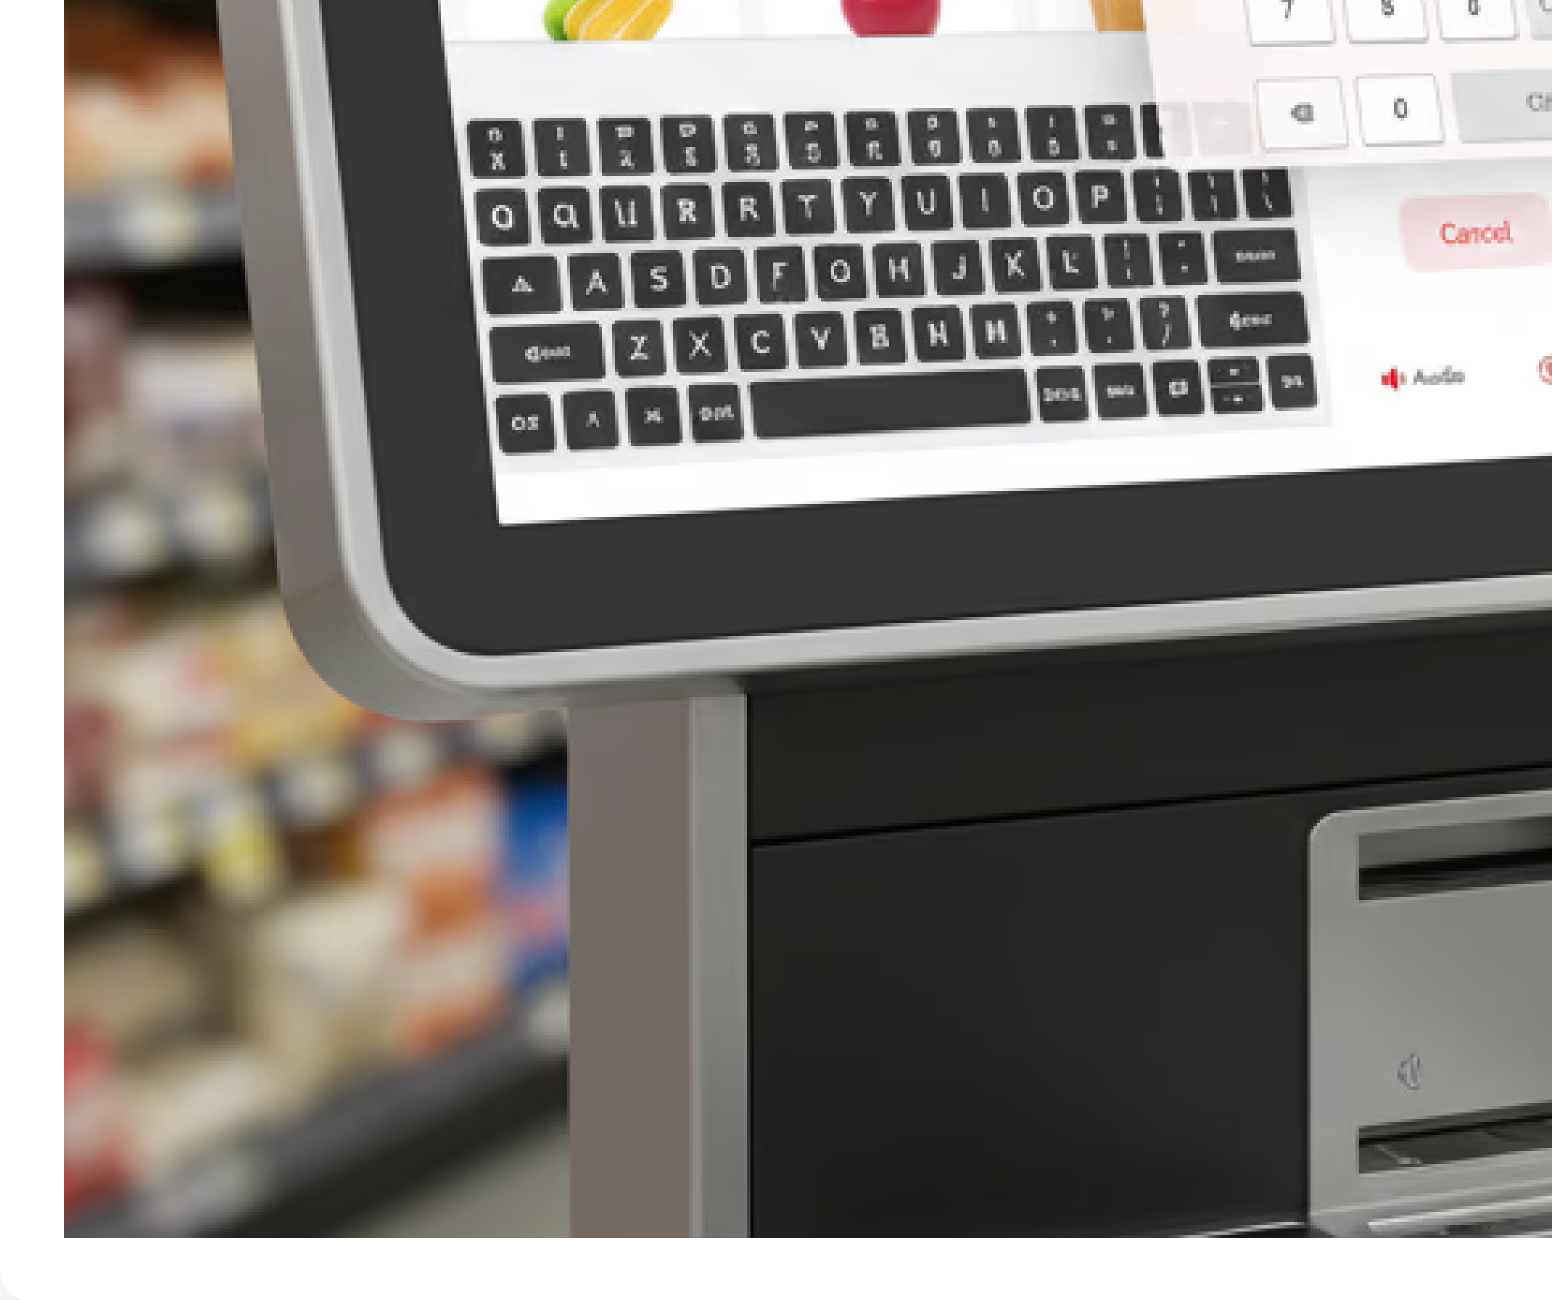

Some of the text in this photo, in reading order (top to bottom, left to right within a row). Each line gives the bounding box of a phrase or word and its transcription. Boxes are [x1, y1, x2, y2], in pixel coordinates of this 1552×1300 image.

[1281, 0, 1294, 18] 7
[1394, 98, 1407, 121] 0
[798, 195, 818, 218] T
[860, 192, 876, 215] Y
[917, 189, 934, 215] U
[1091, 185, 1108, 208] P
[740, 198, 757, 221] R
[953, 256, 966, 279] J
[1005, 250, 1024, 276] K
[586, 269, 606, 295] A
[650, 266, 667, 291] S
[711, 263, 731, 289] D
[689, 331, 711, 359] X
[751, 330, 770, 353] C
[811, 327, 831, 350] V
